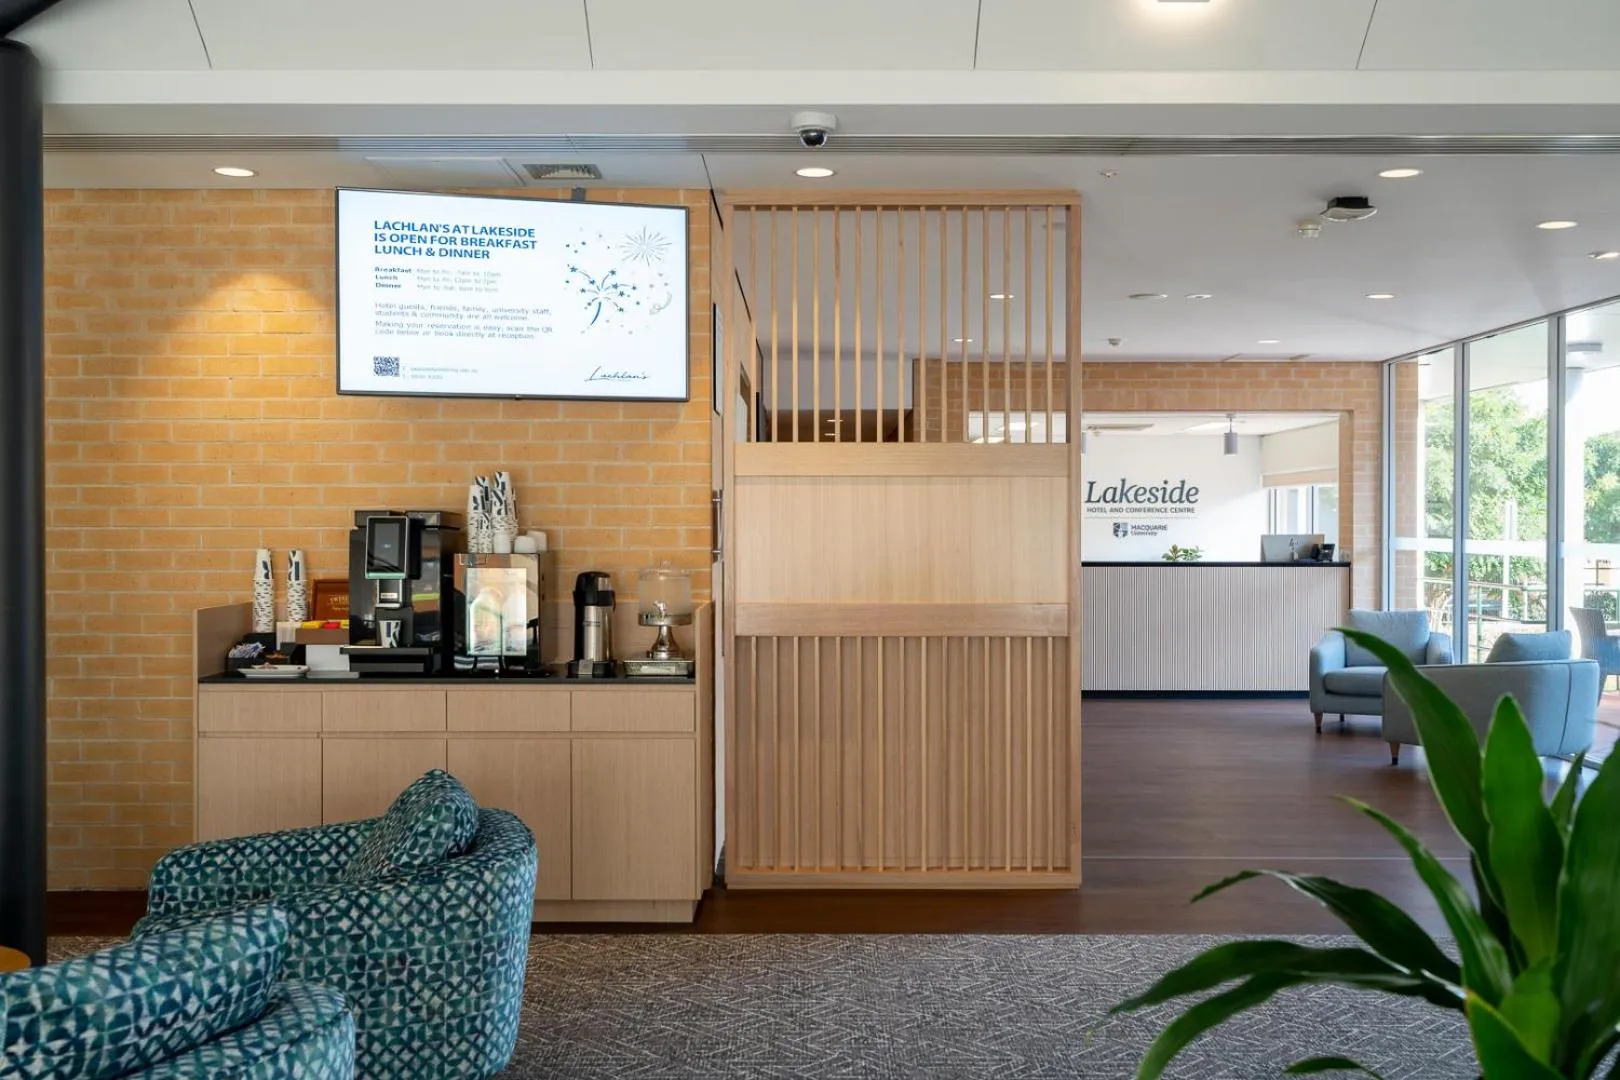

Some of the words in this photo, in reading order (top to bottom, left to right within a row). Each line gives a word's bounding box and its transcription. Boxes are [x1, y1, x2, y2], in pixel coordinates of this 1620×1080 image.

[374, 220, 450, 234] LACHLAN'S
[452, 224, 470, 234] AT
[471, 225, 536, 238] LAKESIDE
[374, 233, 387, 242] IS
[389, 234, 428, 244] OPEN
[430, 235, 458, 246] FOR
[460, 237, 537, 250] BREAKFAST
[374, 244, 422, 256] LUNCH
[425, 247, 436, 257] &
[438, 248, 491, 259] DINNER
[375, 266, 412, 274] Breakfast
[375, 302, 396, 310] Hotel
[492, 307, 528, 316] university
[533, 308, 552, 317] staff,
[420, 312, 463, 321] community
[375, 320, 404, 330] Making
[406, 322, 423, 330] your
[427, 323, 471, 331] reservation
[541, 326, 553, 334] QR
[456, 332, 485, 340] directly
[583, 365, 649, 382] Lachlan's
[1084, 477, 1200, 504] Lakeside
[1086, 506, 1107, 514] HOTEL
[1109, 506, 1124, 514] AND
[1125, 506, 1169, 514] CONFERENCE
[1170, 506, 1196, 514] CENTRE
[1130, 524, 1168, 532] MACQUARIE
